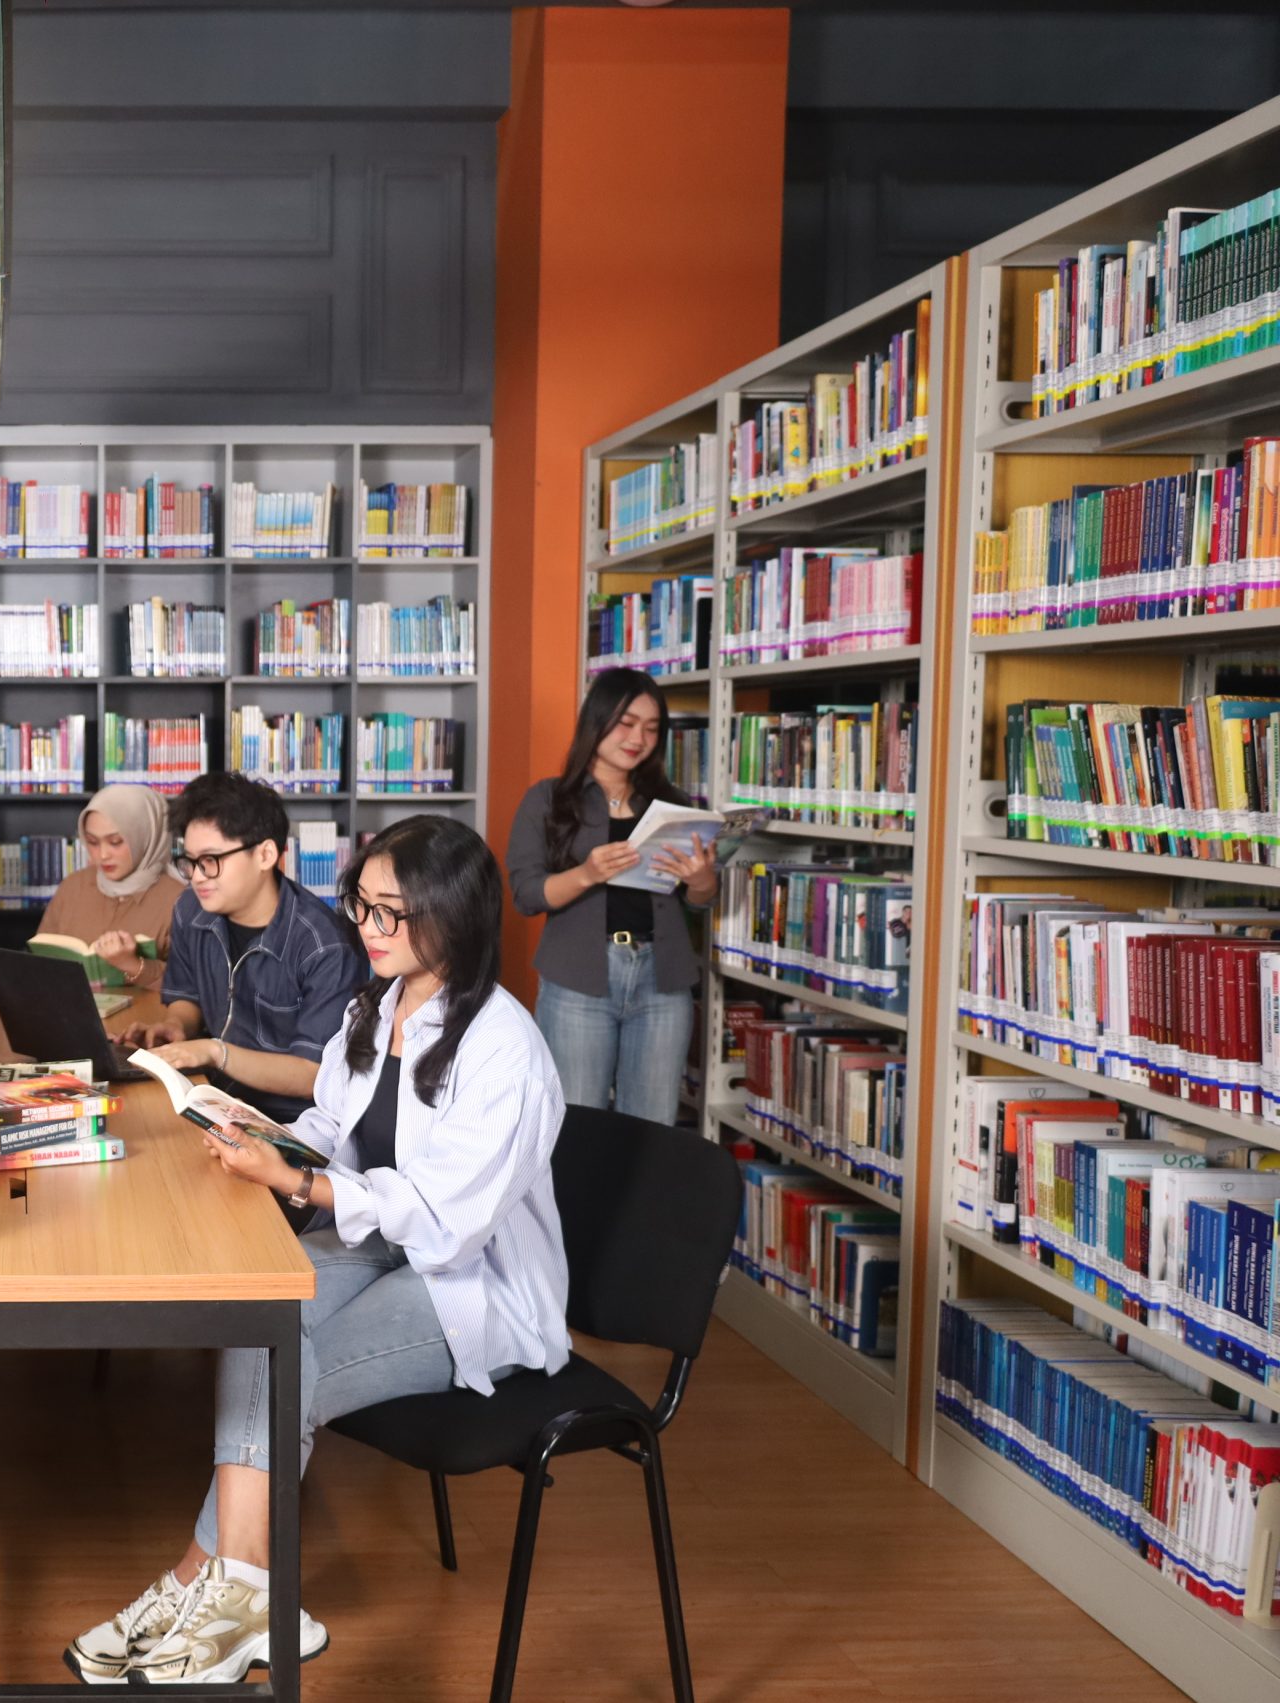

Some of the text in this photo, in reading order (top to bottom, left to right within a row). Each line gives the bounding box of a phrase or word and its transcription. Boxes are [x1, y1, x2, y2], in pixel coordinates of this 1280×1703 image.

[18, 1129, 29, 1141] RISK
[28, 1123, 58, 1138] MANAGEMENT
[58, 1121, 67, 1132] FOR
